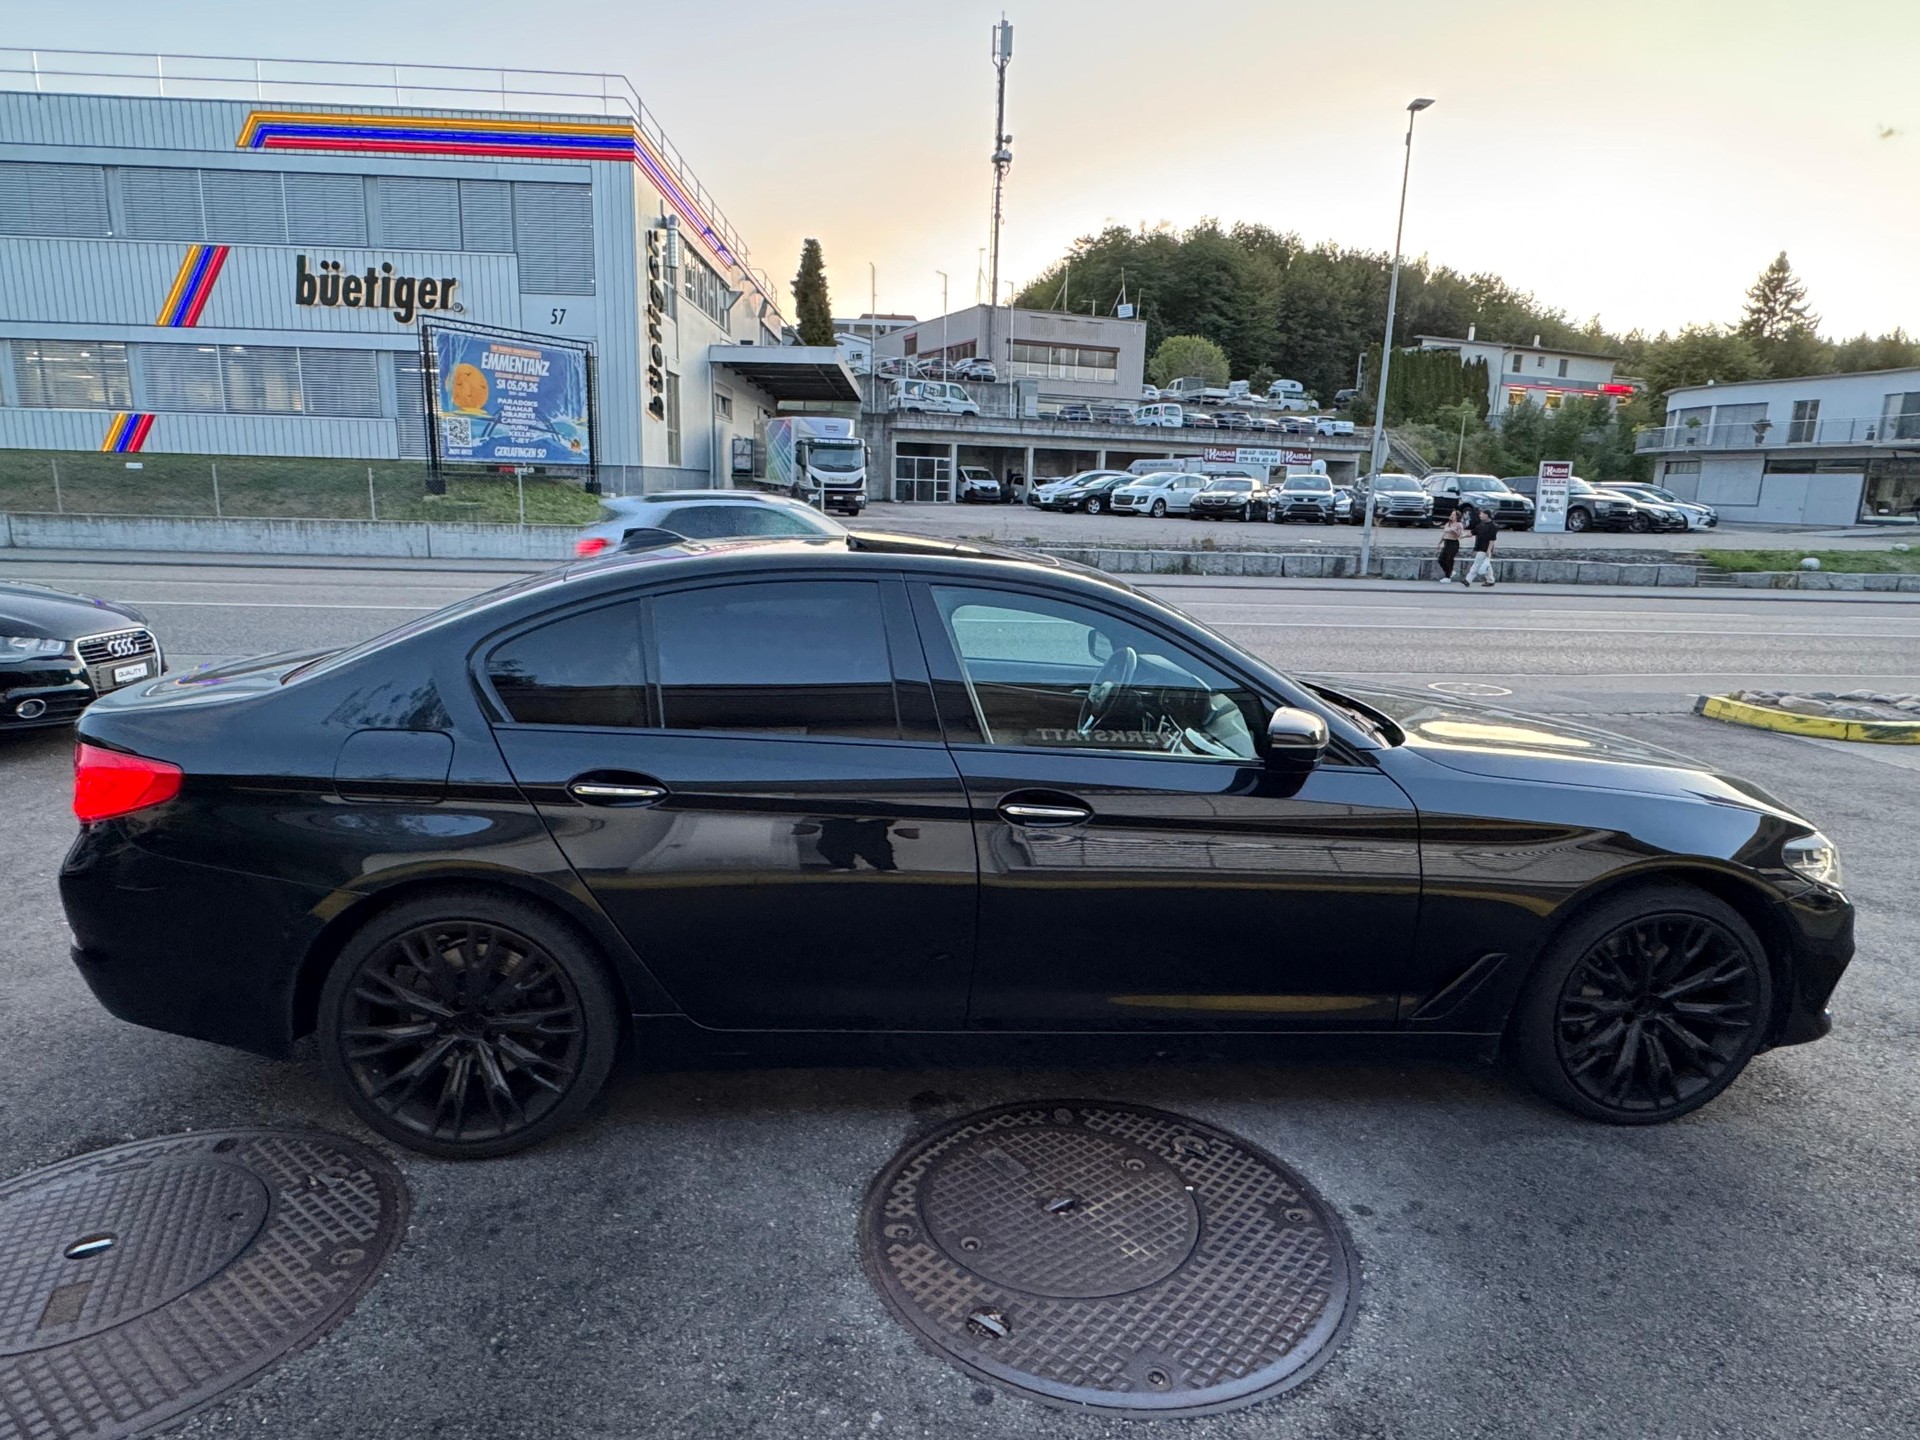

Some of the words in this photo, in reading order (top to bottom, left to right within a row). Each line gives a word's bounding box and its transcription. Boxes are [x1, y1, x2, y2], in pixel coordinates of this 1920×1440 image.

[296, 255, 456, 323] büetiger
[550, 308, 567, 325] 57
[481, 351, 550, 377] EMMENTANZ
